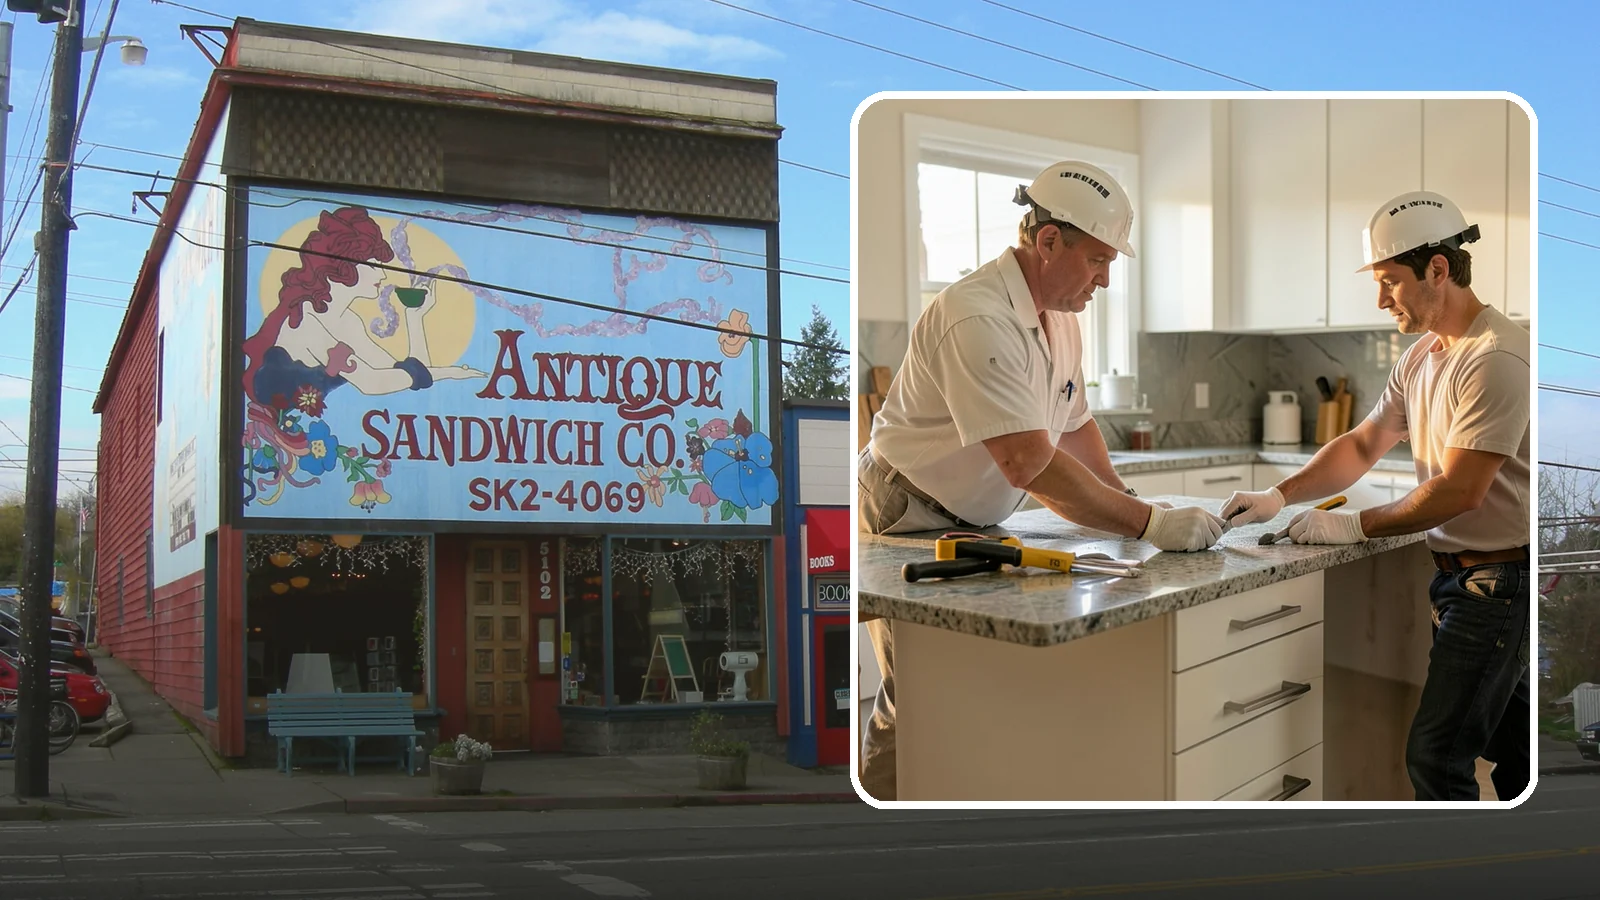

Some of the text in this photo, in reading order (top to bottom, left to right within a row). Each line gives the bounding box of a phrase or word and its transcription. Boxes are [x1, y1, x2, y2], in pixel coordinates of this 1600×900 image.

[476, 329, 724, 421] ANTIQUE
[361, 409, 685, 469] SANDWICH CO.
[468, 477, 647, 513] SK2-4069
[809, 555, 835, 569] BOOKS
